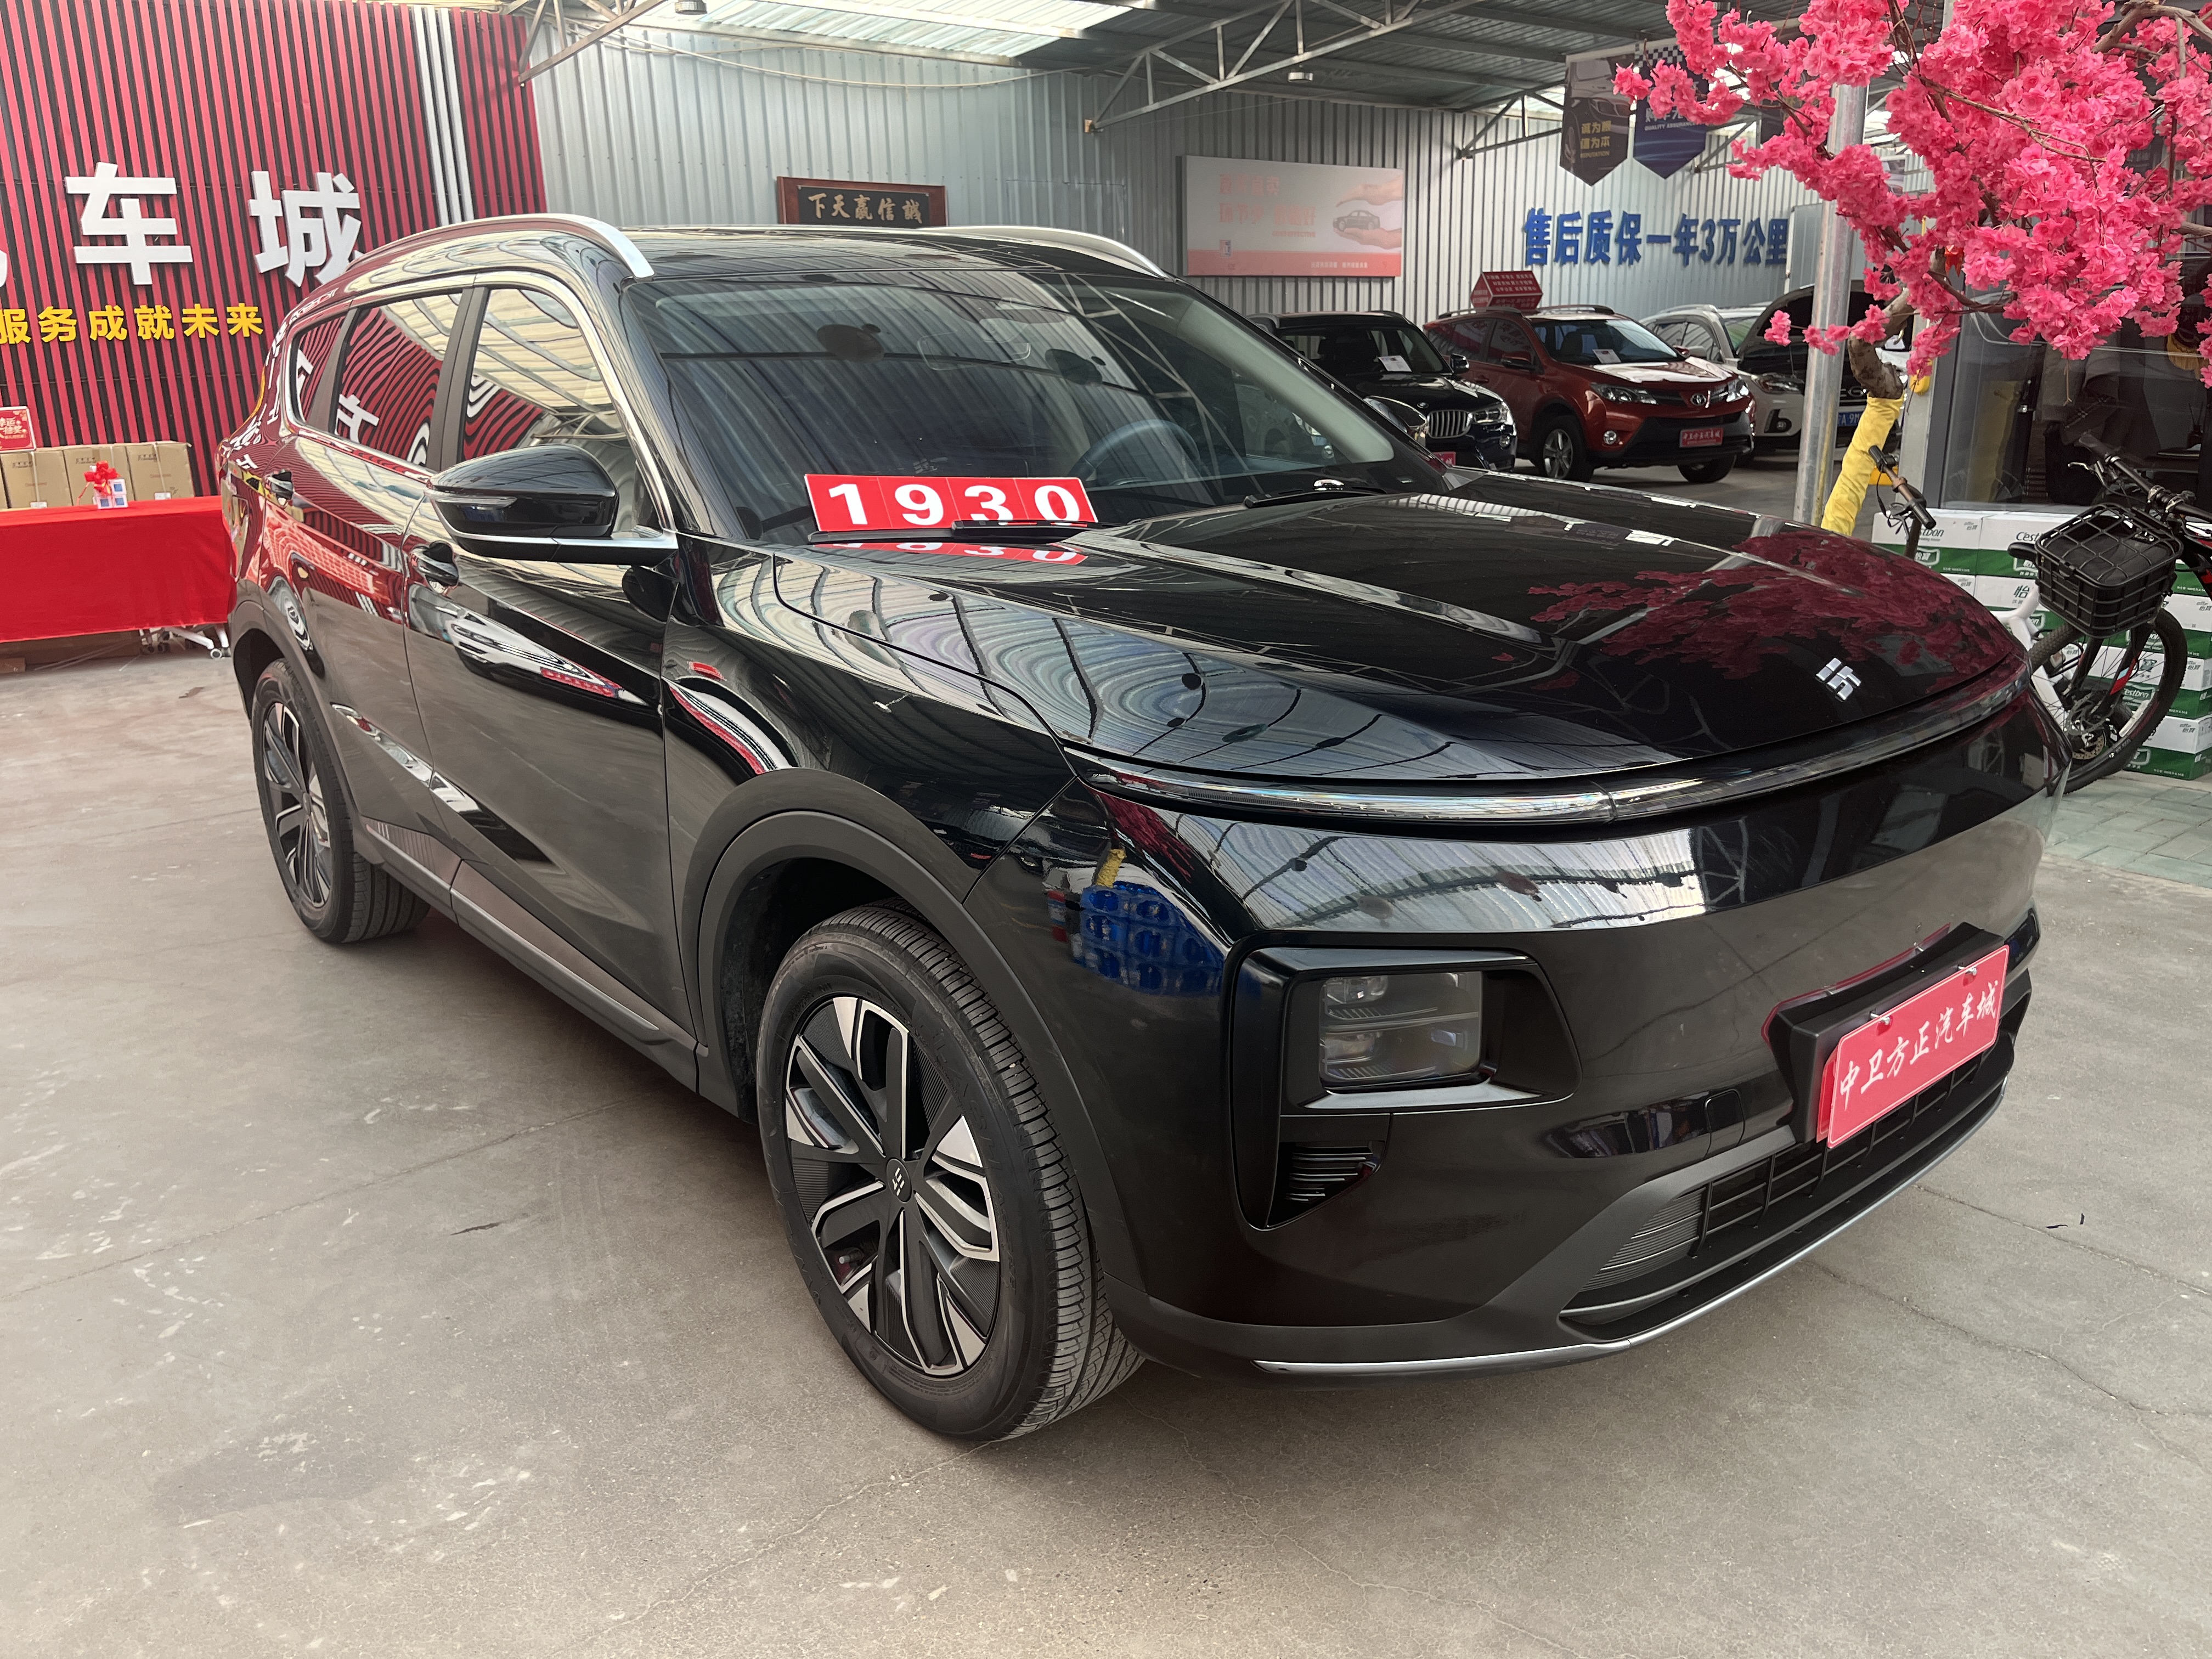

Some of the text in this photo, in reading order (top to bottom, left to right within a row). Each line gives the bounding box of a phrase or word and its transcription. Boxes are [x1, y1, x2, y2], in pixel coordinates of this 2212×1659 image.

[0, 161, 364, 287] 车城
[1524, 207, 1789, 267] 售后质保一年3万公里
[0, 302, 263, 345] 服务成就未来
[828, 483, 1080, 526] 1930
[2013, 585, 2030, 598] 怡
[1839, 980, 1998, 1111] 中卫方正汽车城
